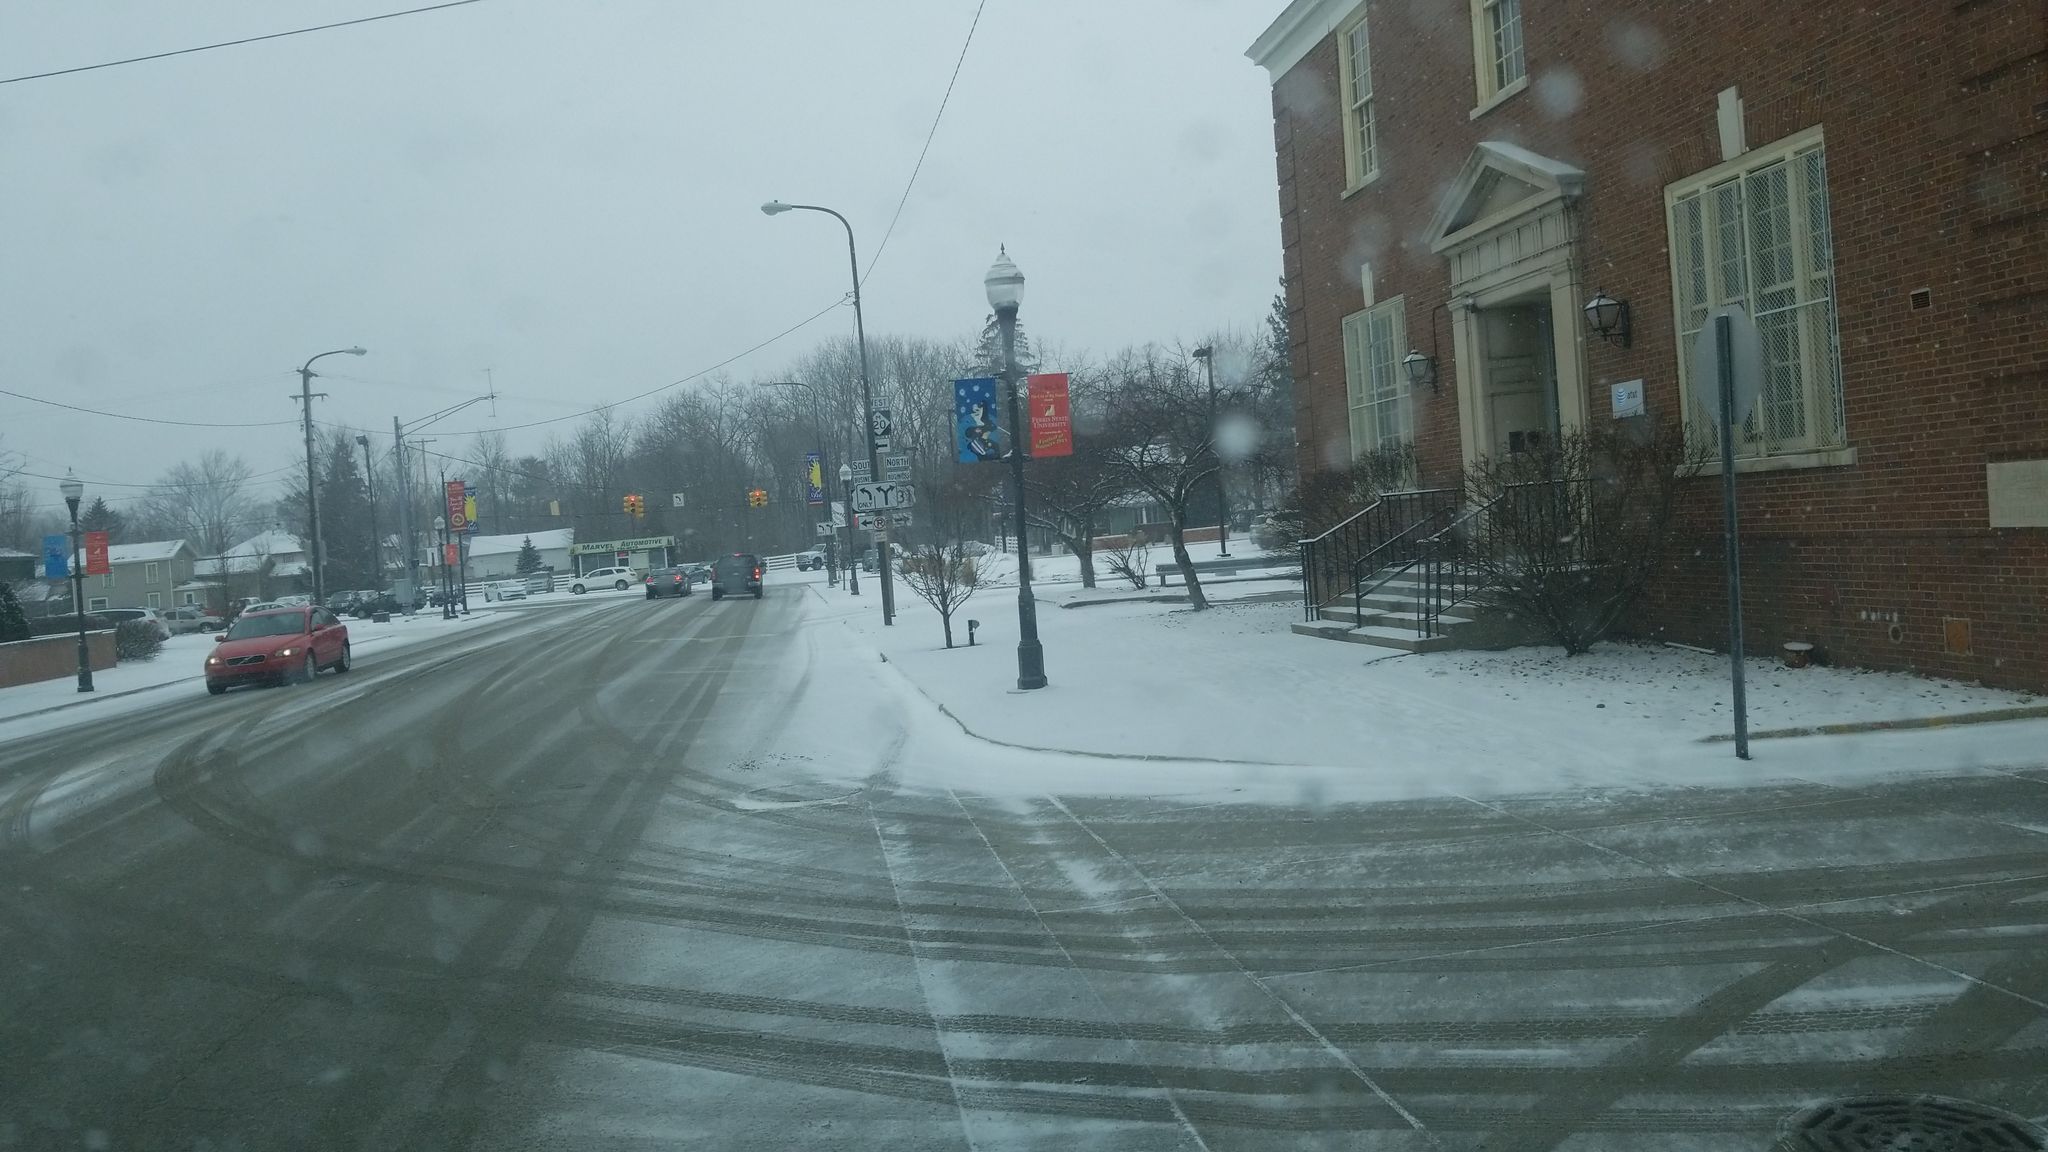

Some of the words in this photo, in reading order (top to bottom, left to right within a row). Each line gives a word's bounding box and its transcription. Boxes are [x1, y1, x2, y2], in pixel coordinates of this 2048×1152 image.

[872, 399, 887, 407] EST
[873, 420, 886, 430] 20
[852, 460, 870, 470] SOUT
[886, 458, 909, 467] NORTH
[854, 475, 871, 483] BUSINE
[582, 543, 614, 552] MARVEL
[621, 538, 663, 548] AUTOMOTIVE
